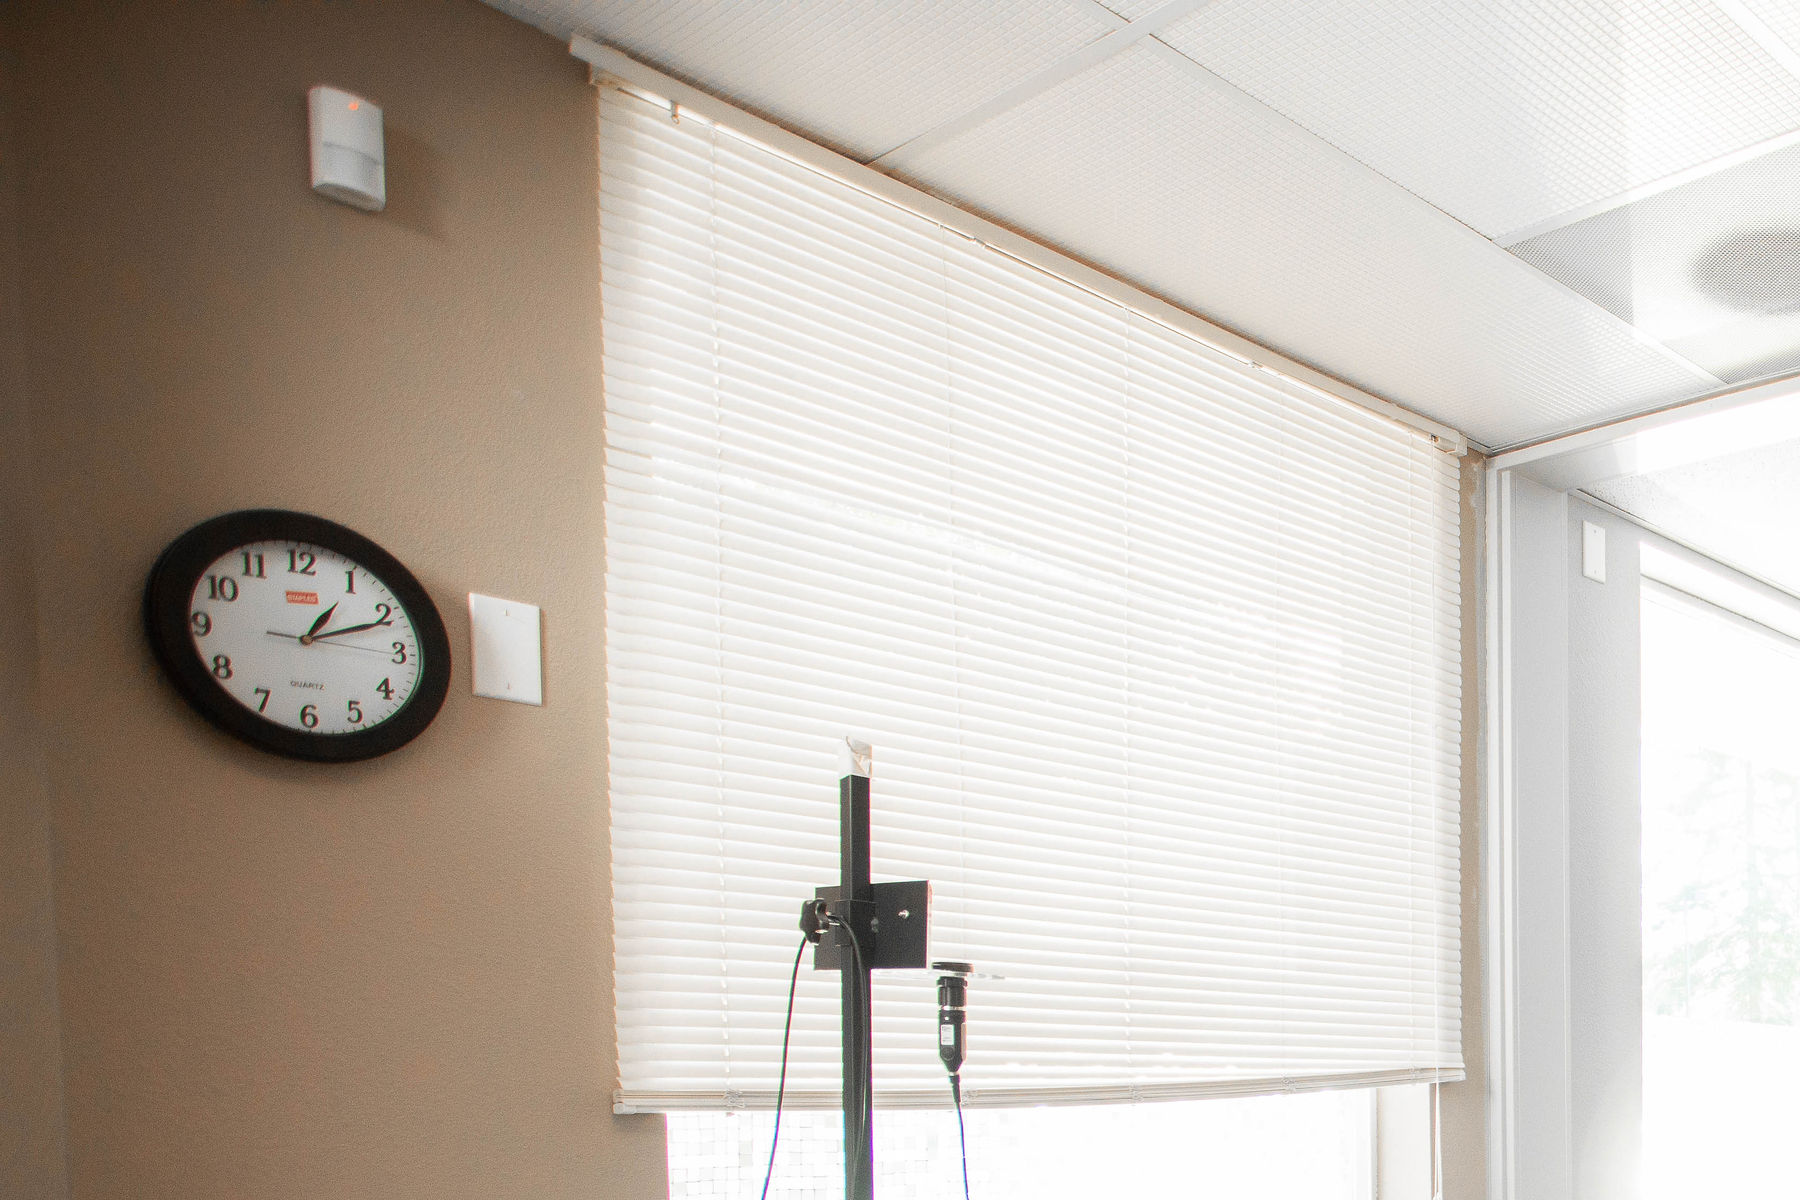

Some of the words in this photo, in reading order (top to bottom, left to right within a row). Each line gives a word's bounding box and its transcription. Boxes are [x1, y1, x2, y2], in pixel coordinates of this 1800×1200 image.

[241, 551, 267, 580] 11
[287, 549, 316, 577] 12
[207, 575, 240, 602] 10
[344, 569, 358, 595] 1
[191, 611, 212, 638] 9
[374, 602, 393, 628] 2
[391, 641, 408, 666] 3
[211, 654, 233, 680] 8
[290, 679, 325, 691] QUARTZ
[376, 677, 395, 701] 4
[253, 687, 271, 714] 7
[346, 700, 364, 725] 5
[300, 704, 319, 729] 6
